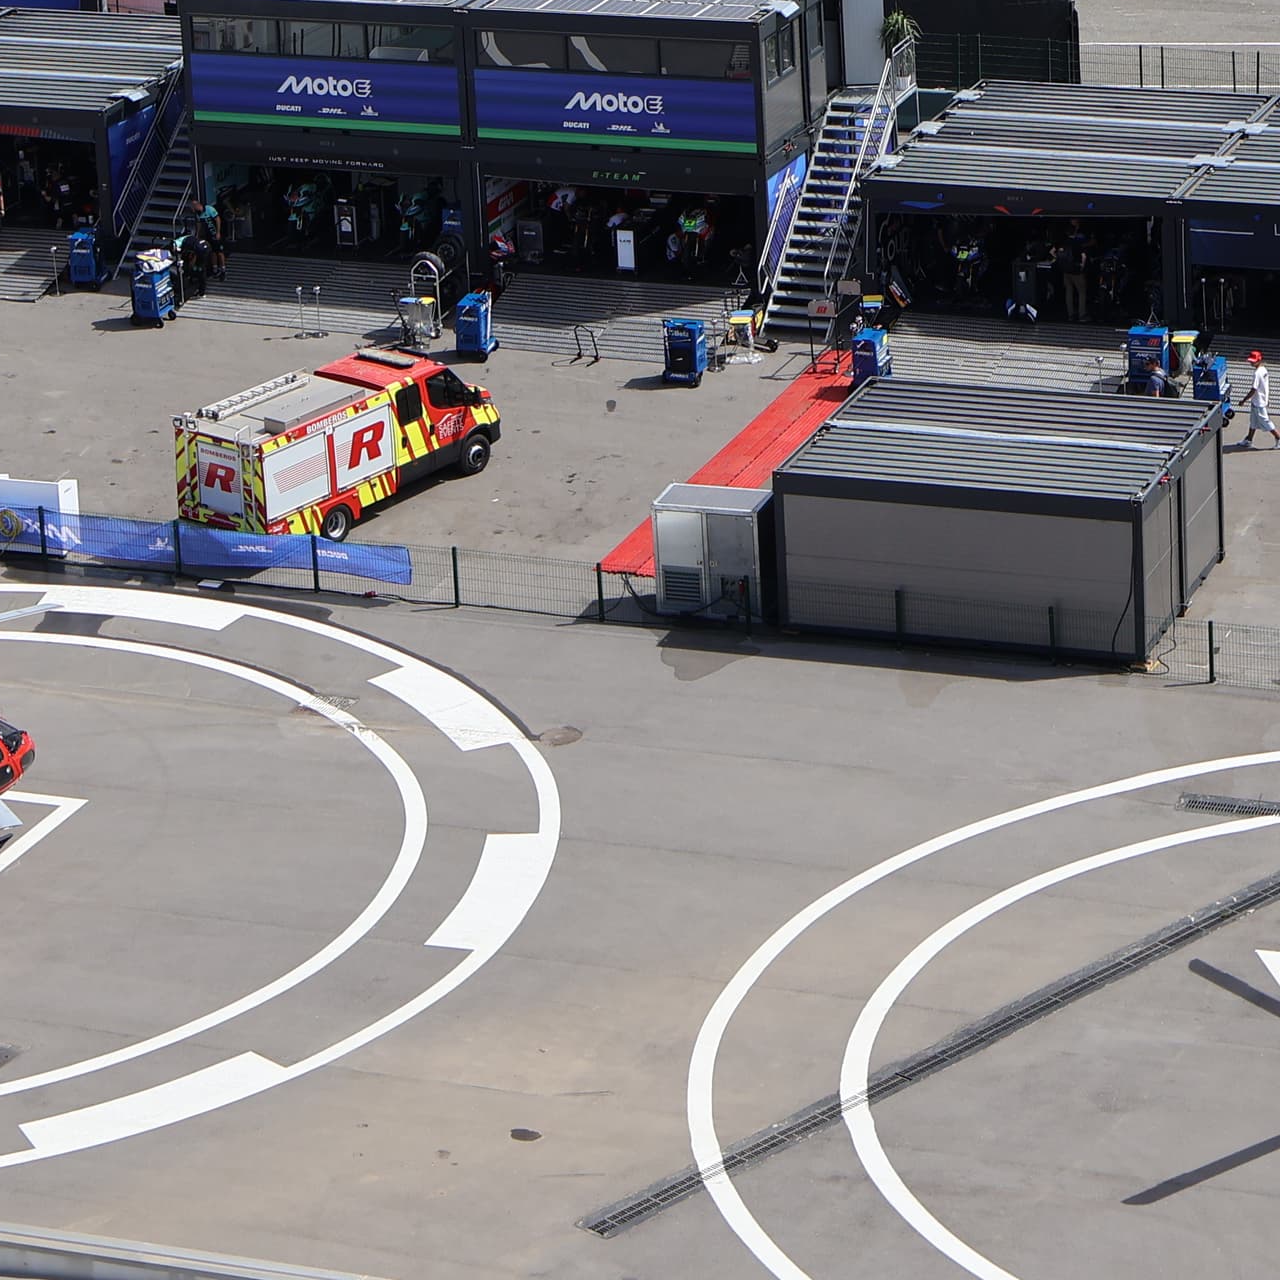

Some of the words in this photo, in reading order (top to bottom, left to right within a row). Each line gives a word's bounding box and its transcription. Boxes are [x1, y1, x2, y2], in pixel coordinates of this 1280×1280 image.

[277, 75, 373, 98] MotoE
[276, 104, 301, 113] DUCATI
[564, 91, 664, 114] MotoE
[563, 120, 589, 129] DUCATI
[592, 171, 640, 181] E-TEAM
[306, 410, 349, 436] BOMBEROS
[199, 447, 237, 462] BOMBEROS
[348, 420, 385, 471] R
[204, 461, 236, 494] R
